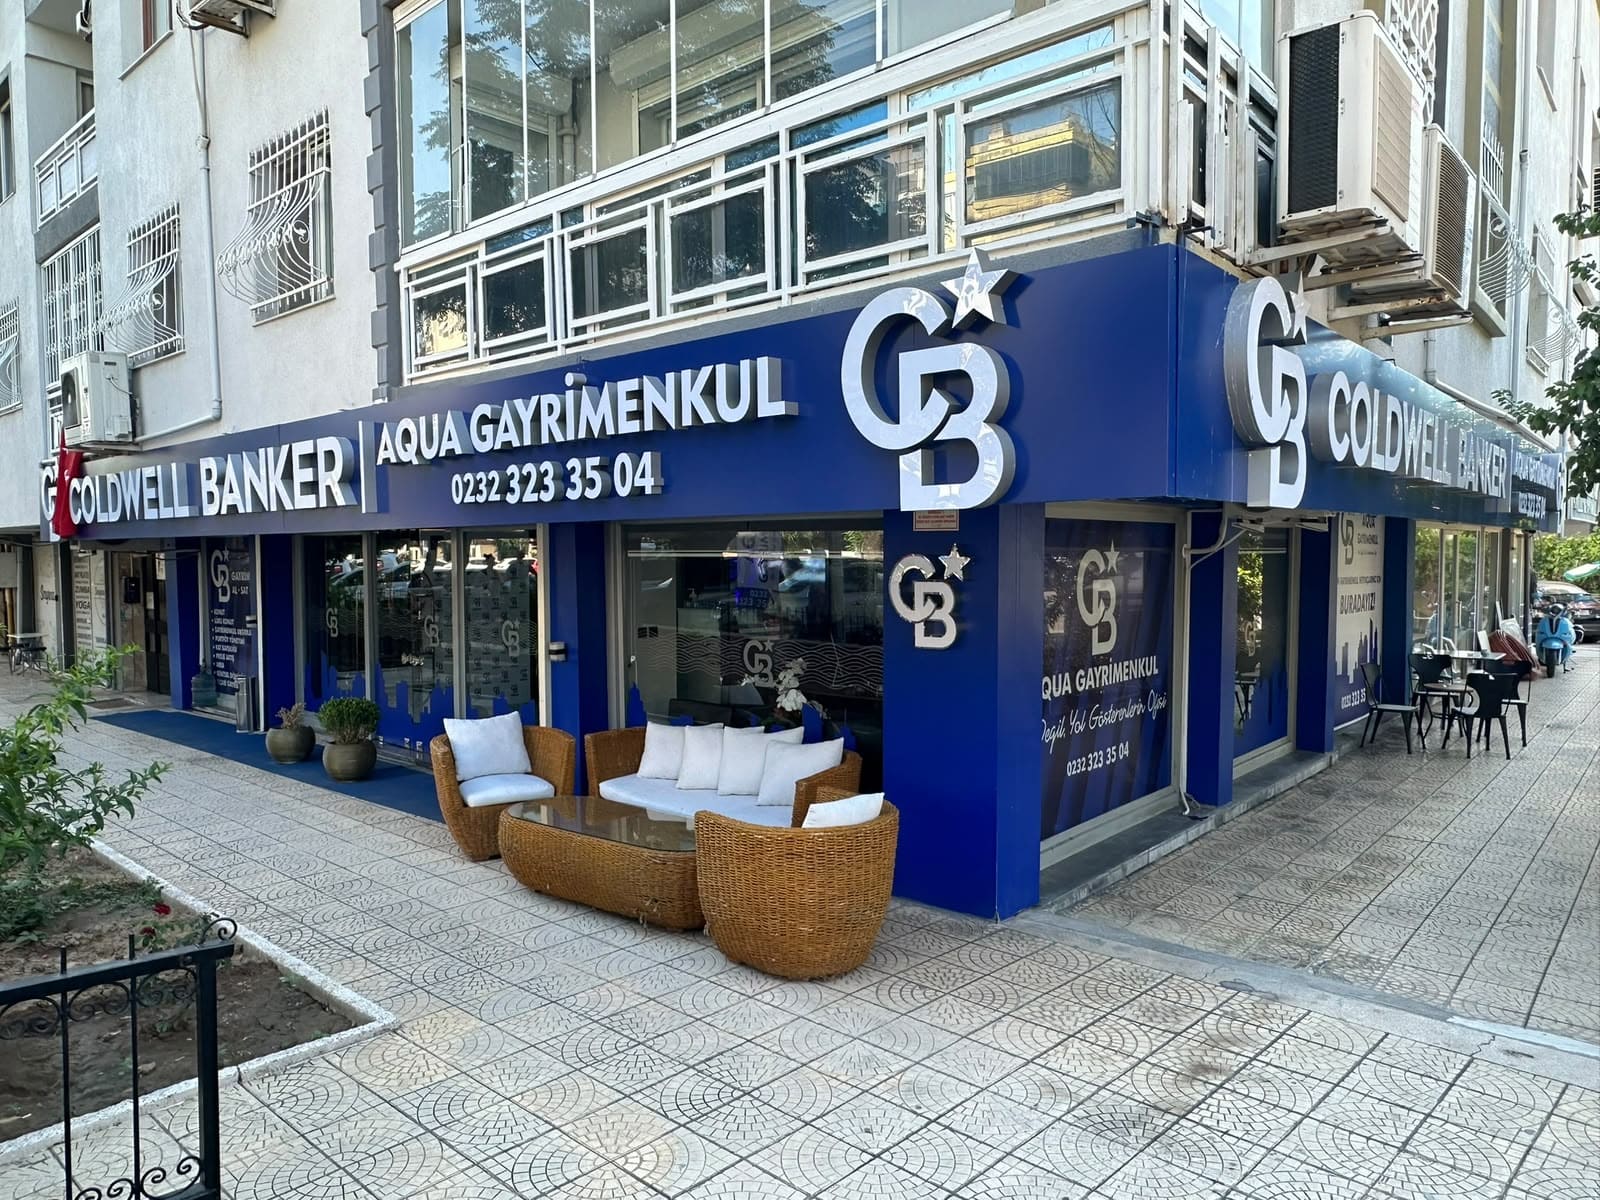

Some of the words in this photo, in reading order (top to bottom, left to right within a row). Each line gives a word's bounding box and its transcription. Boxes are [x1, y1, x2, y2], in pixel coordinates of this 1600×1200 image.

[377, 410, 463, 466] AQUA
[470, 355, 787, 453] GAYRİMENKUL
[841, 287, 1003, 512] CB
[1328, 370, 1451, 486] COLDWELL
[1456, 427, 1507, 499] BANKER
[68, 462, 190, 526] COLDWELL
[200, 436, 348, 517] BANKER
[451, 469, 501, 505] 0232
[505, 460, 557, 505] 323
[565, 456, 603, 501] 35
[613, 450, 655, 496] 04
[889, 553, 958, 649] CB
[1076, 548, 1118, 656] CB
[1041, 672, 1072, 701] QUA
[1075, 656, 1159, 692] GAYRİMENKUL
[1069, 709, 1087, 735] Yol
[1066, 757, 1086, 777] 0232
[1087, 750, 1104, 771] 323
[1105, 745, 1117, 765] 35
[1118, 741, 1129, 760] 04
